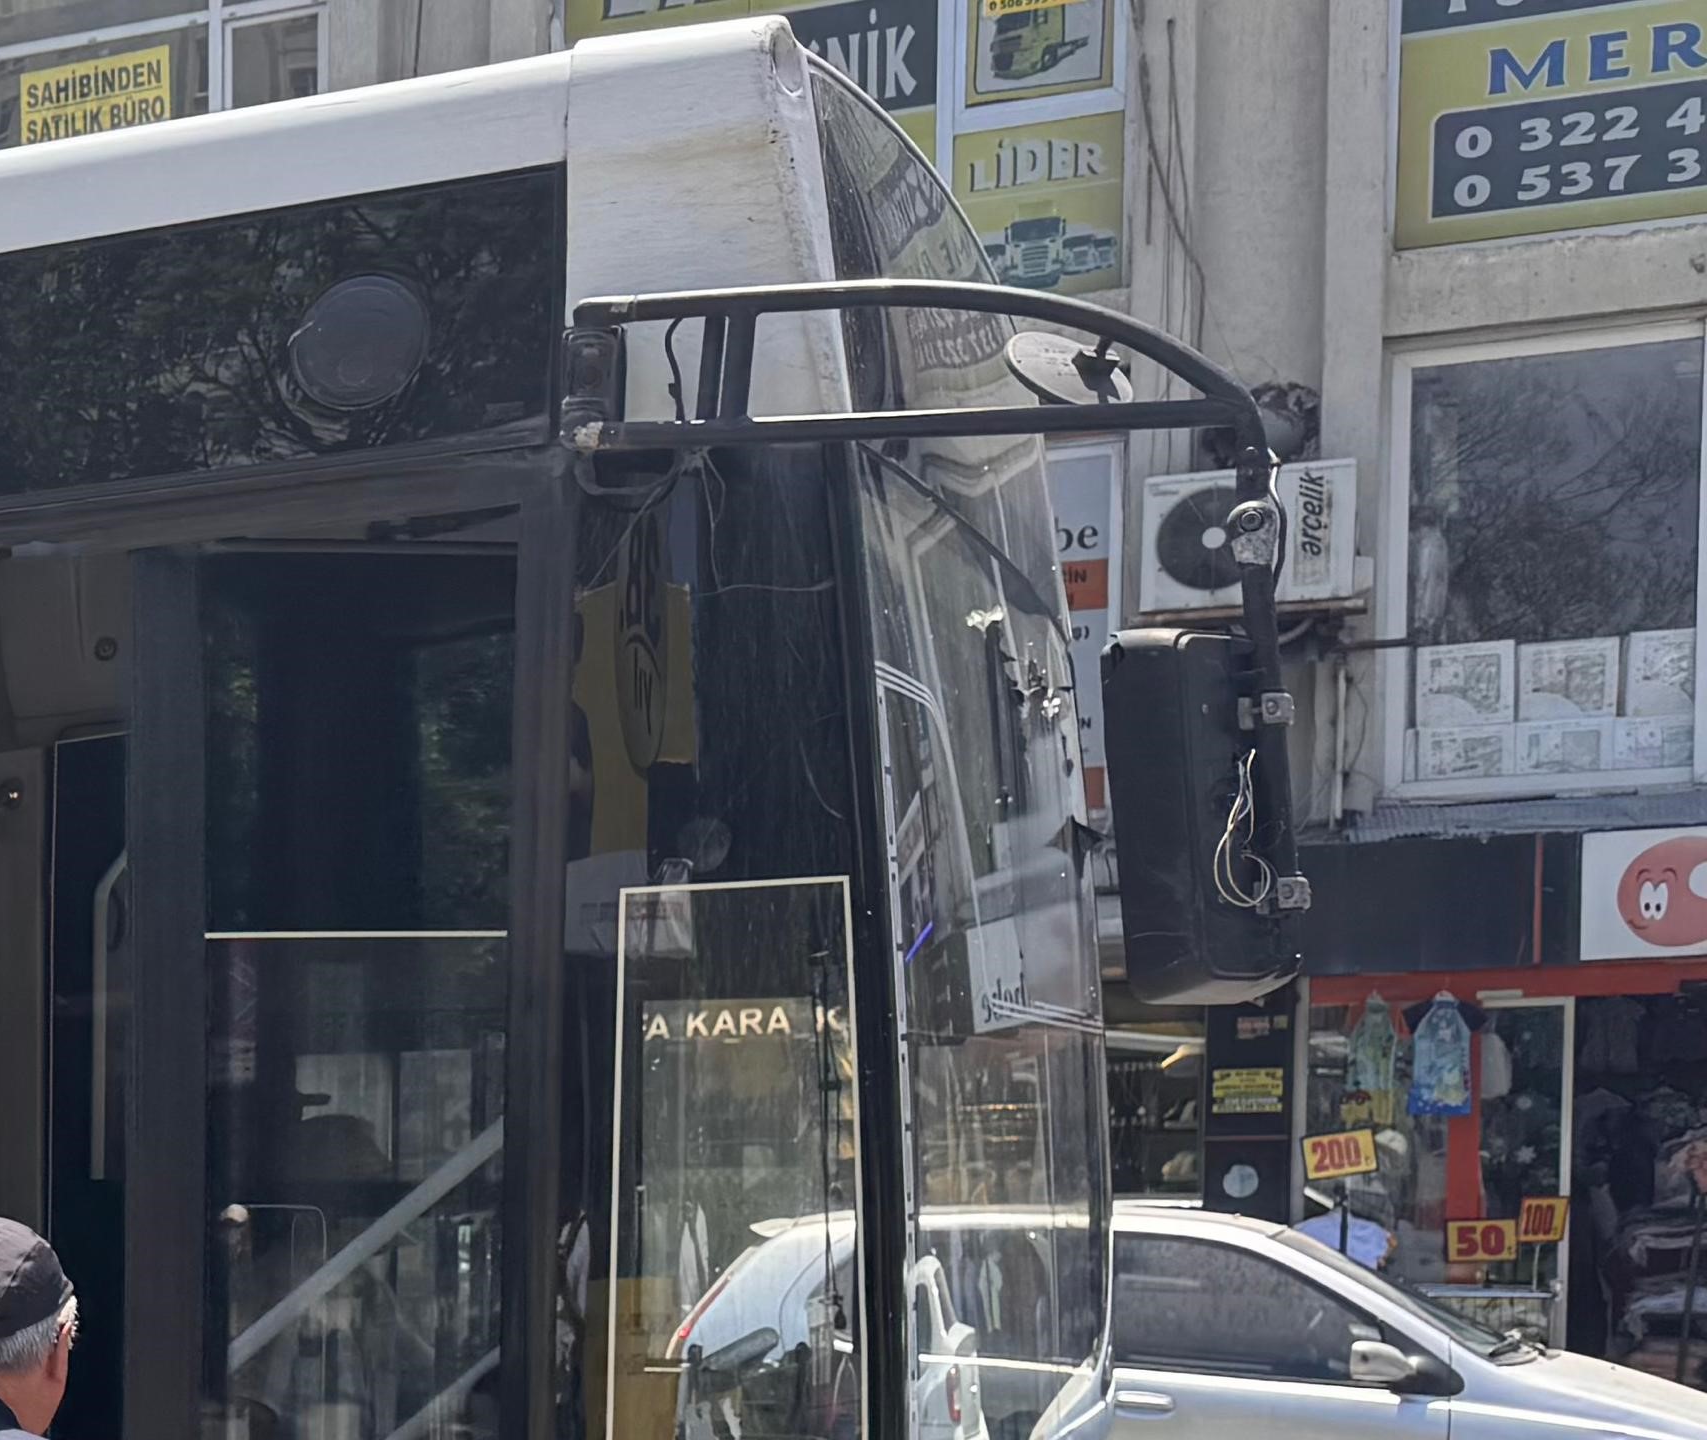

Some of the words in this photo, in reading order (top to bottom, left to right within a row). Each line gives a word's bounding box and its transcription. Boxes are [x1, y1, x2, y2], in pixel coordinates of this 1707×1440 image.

[809, 8, 918, 98] NİK
[26, 59, 162, 109] SAHİBİNDEN
[26, 106, 103, 144] SATILIK
[110, 95, 165, 127] BÜRO
[1455, 126, 1492, 158] 0
[1519, 106, 1640, 151] 322
[1666, 97, 1706, 135] 4
[969, 138, 1108, 193] LİDER
[1454, 175, 1491, 207] 0
[1517, 154, 1642, 201] 537
[1667, 148, 1701, 182] 3
[1300, 470, 1325, 556] arçelik
[685, 1006, 792, 1038] KARA
